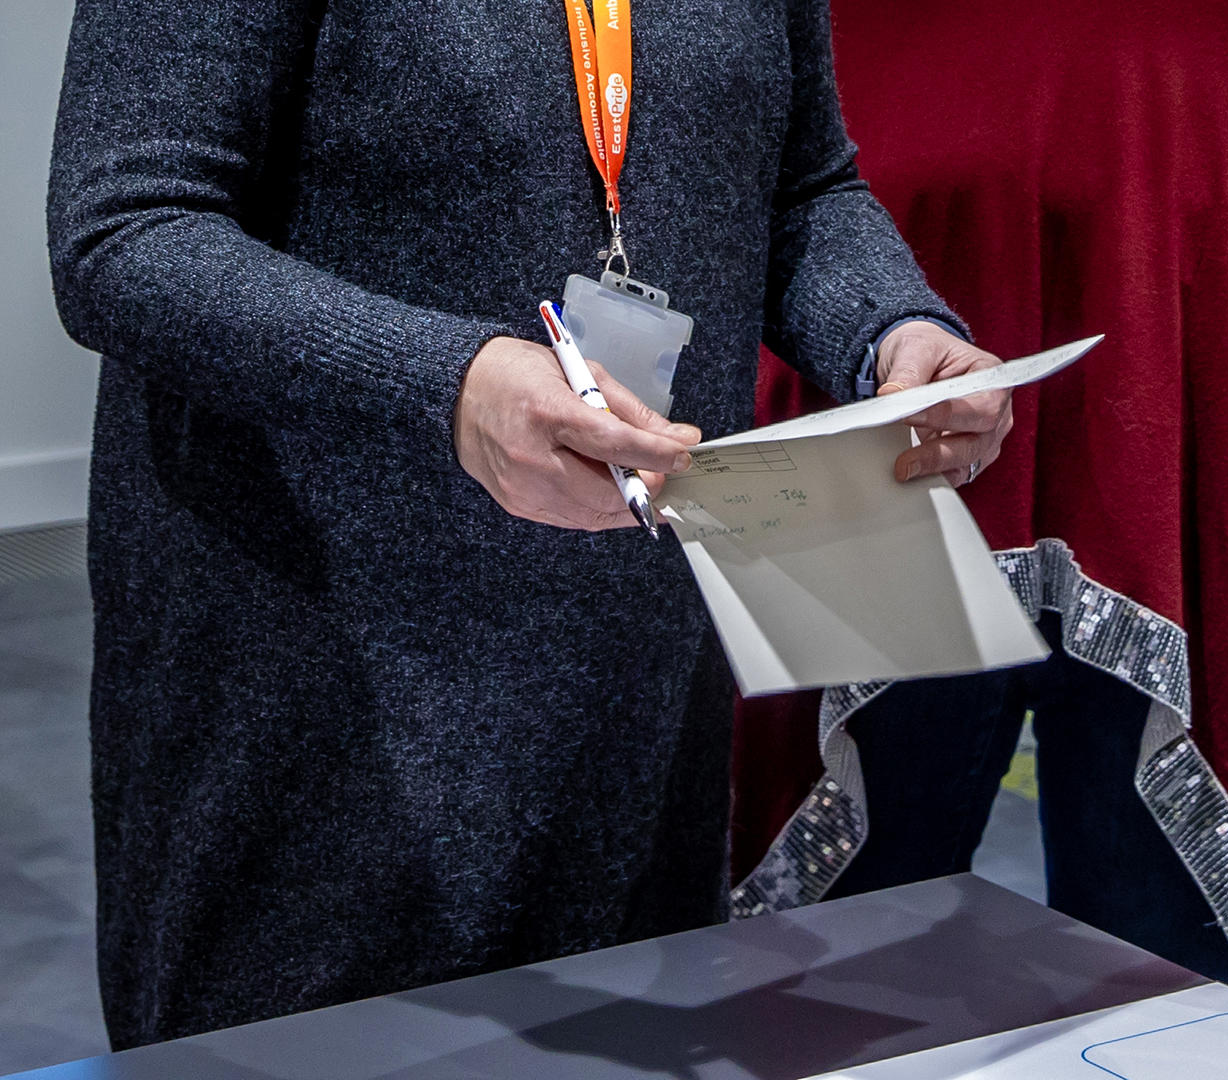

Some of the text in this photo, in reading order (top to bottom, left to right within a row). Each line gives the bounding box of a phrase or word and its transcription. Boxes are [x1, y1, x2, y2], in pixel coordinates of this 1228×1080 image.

[575, 7, 592, 69] Inclusive
[585, 72, 606, 160] Accountable
[610, 75, 624, 155] EastPride
